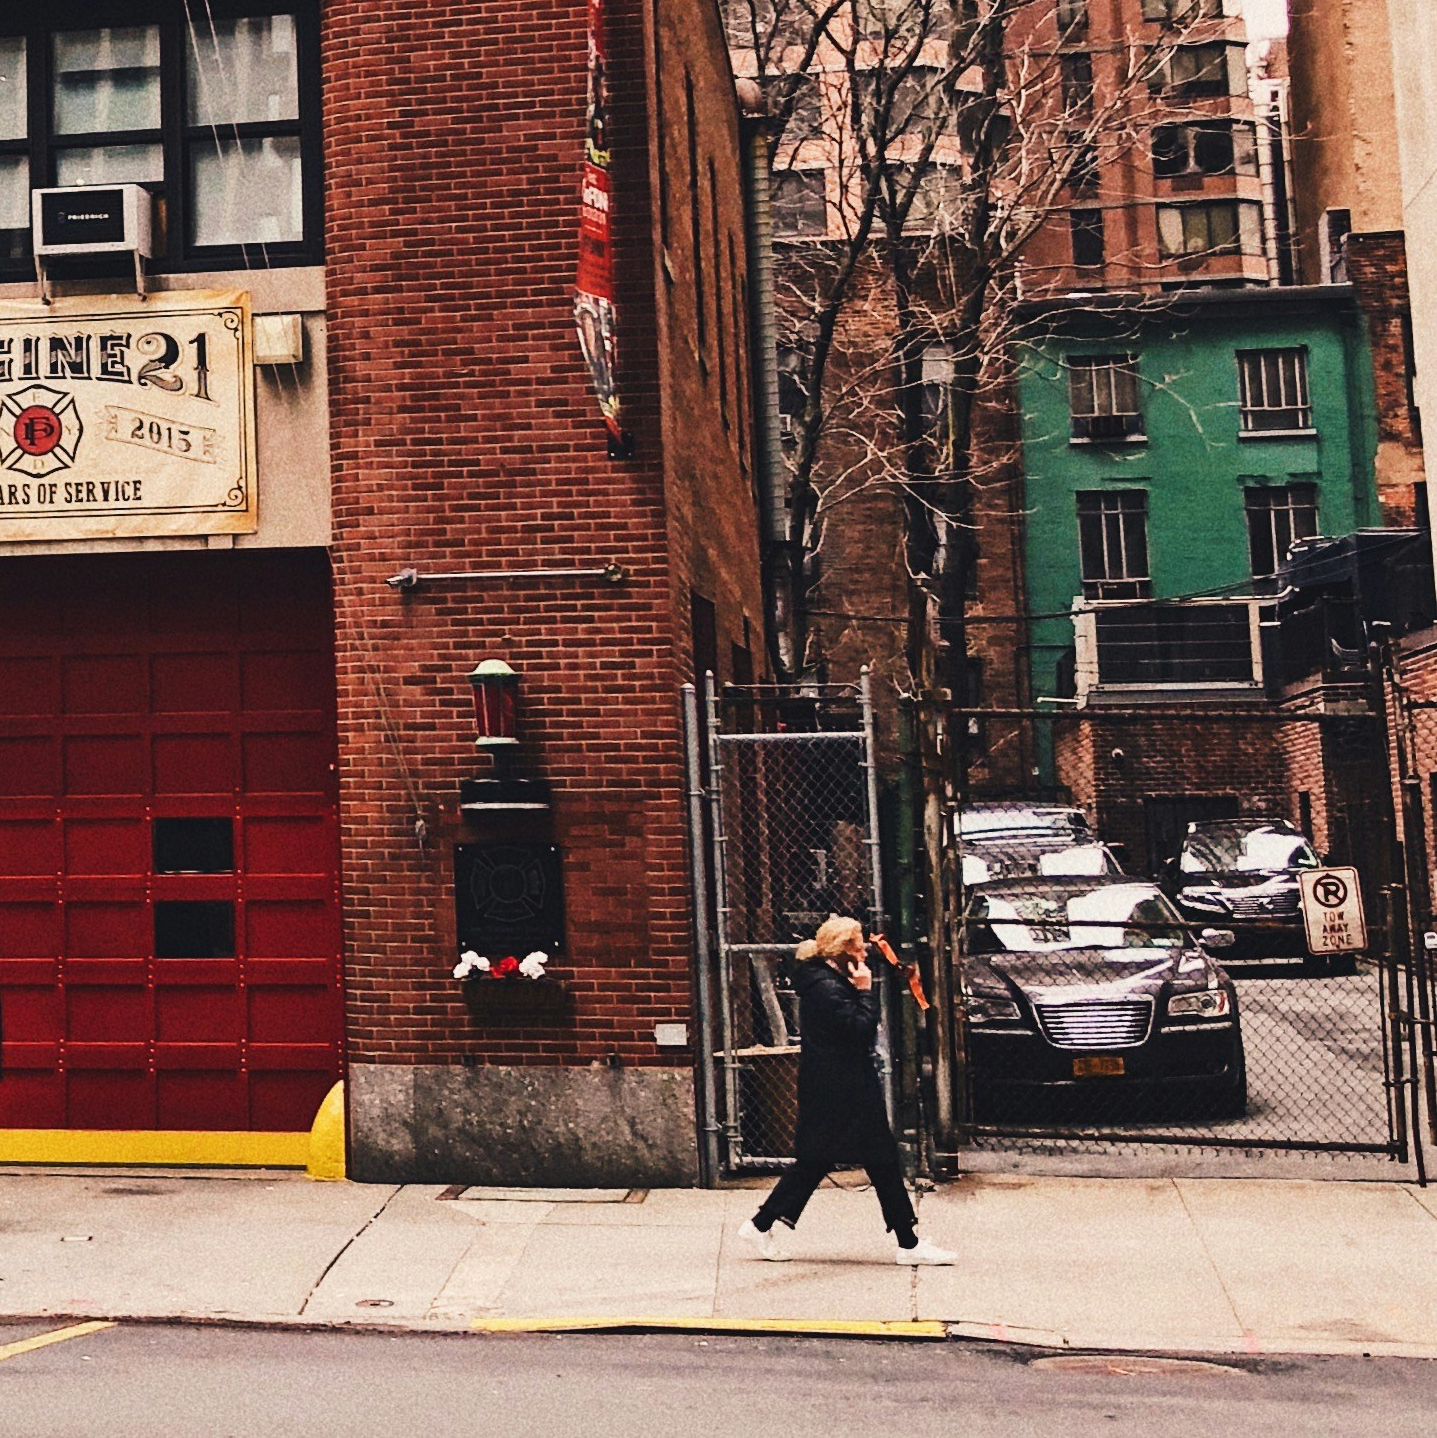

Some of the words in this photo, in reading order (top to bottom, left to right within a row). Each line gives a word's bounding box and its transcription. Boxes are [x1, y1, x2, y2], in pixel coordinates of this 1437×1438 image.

[137, 331, 216, 404] 21
[130, 416, 193, 454] 2015
[36, 482, 59, 505] OF
[63, 479, 143, 504] SERVICE
[1323, 911, 1345, 923] TOW
[1322, 923, 1349, 934] AWAY
[1322, 934, 1353, 946] ZONE
